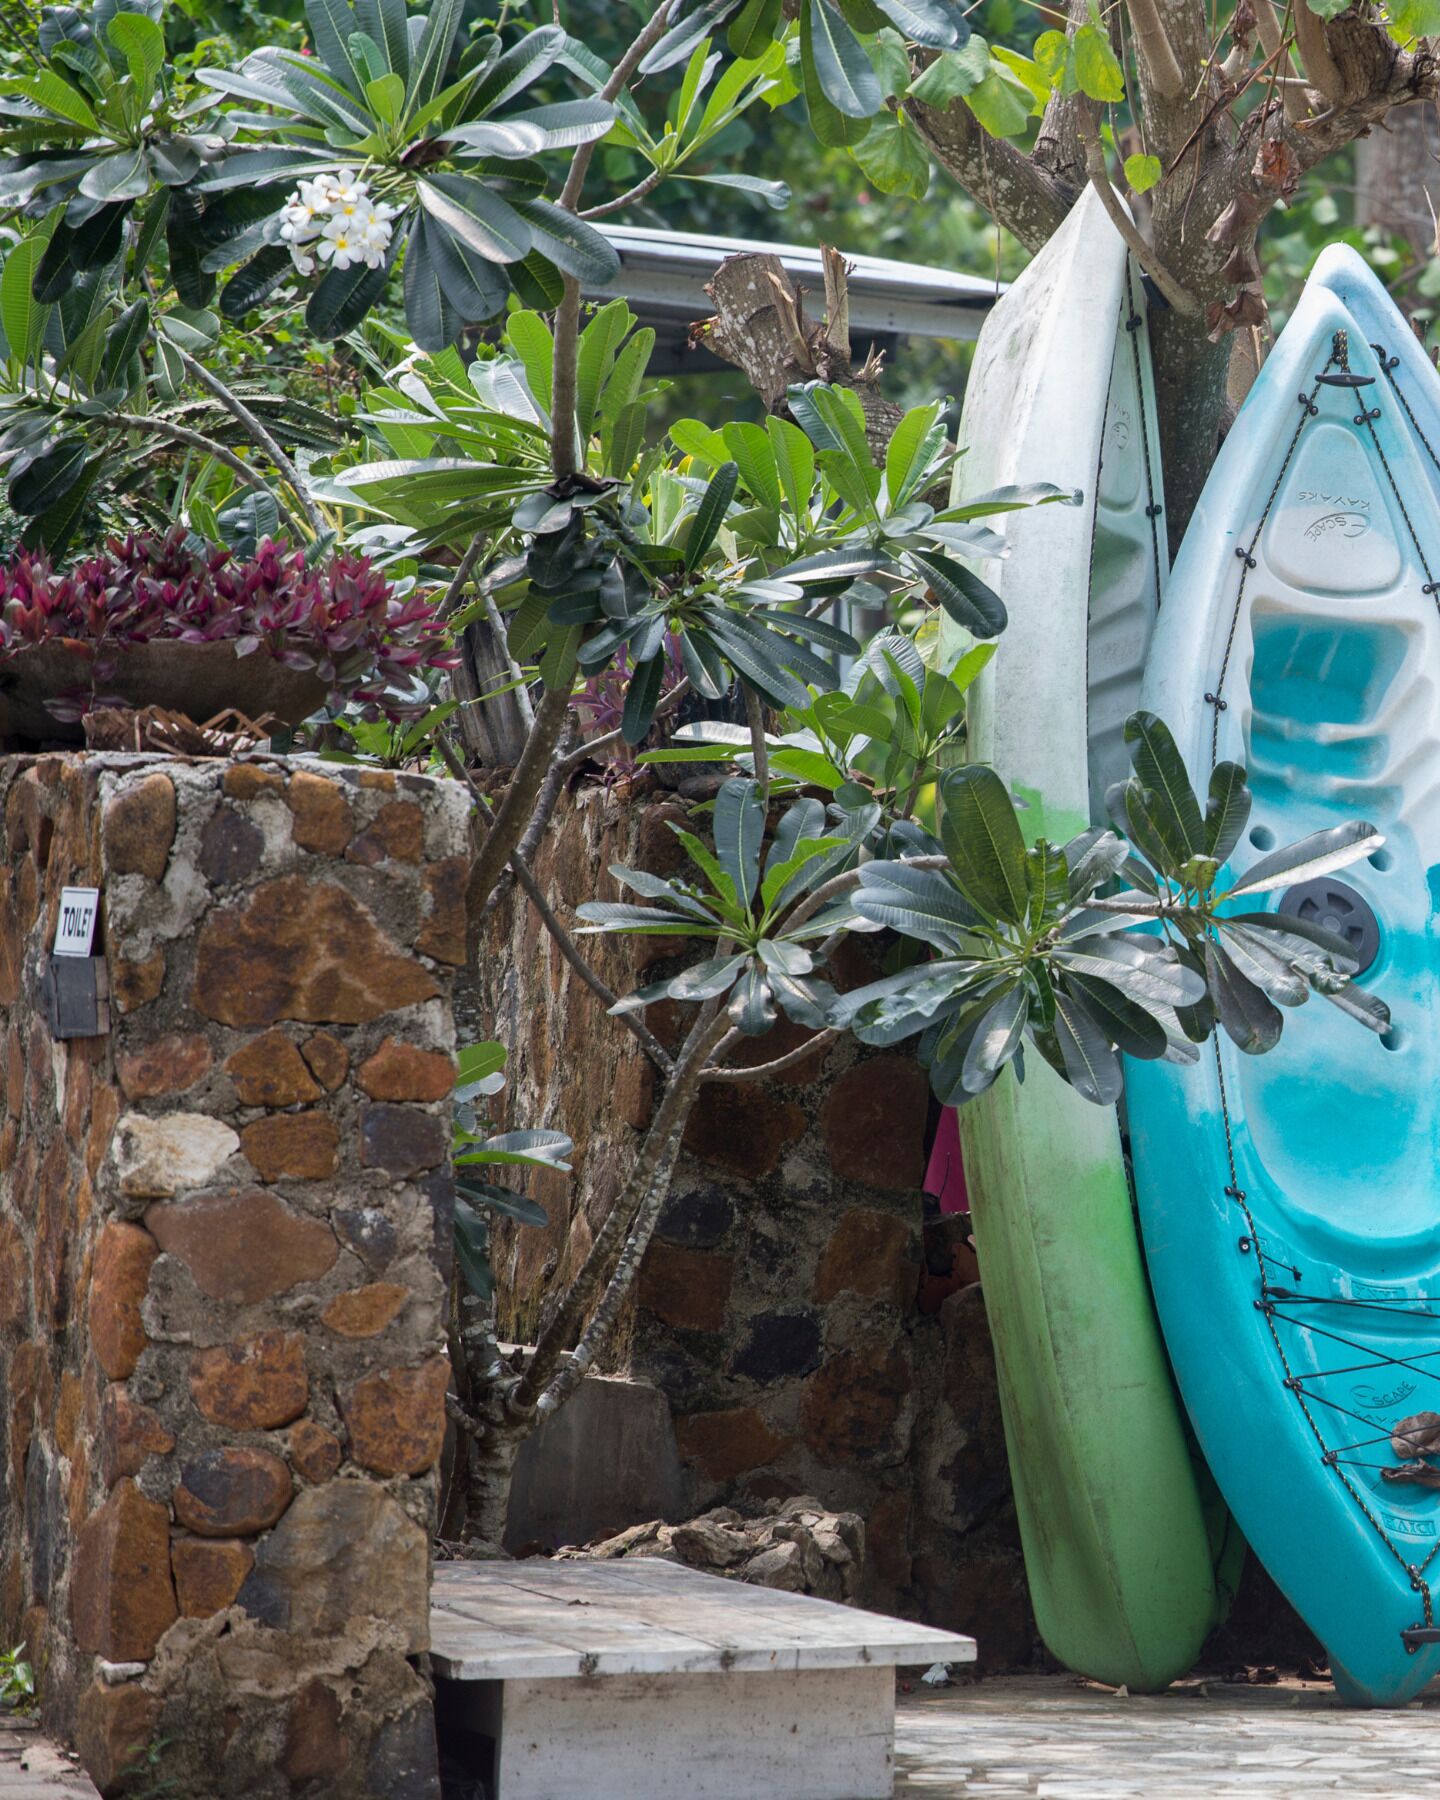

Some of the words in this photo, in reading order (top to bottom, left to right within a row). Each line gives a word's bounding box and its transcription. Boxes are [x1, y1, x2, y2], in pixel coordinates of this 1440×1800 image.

[1298, 491, 1371, 511] KAYAKS
[62, 906, 93, 938] TOILET
[1385, 1518, 1433, 1534] DIVE
